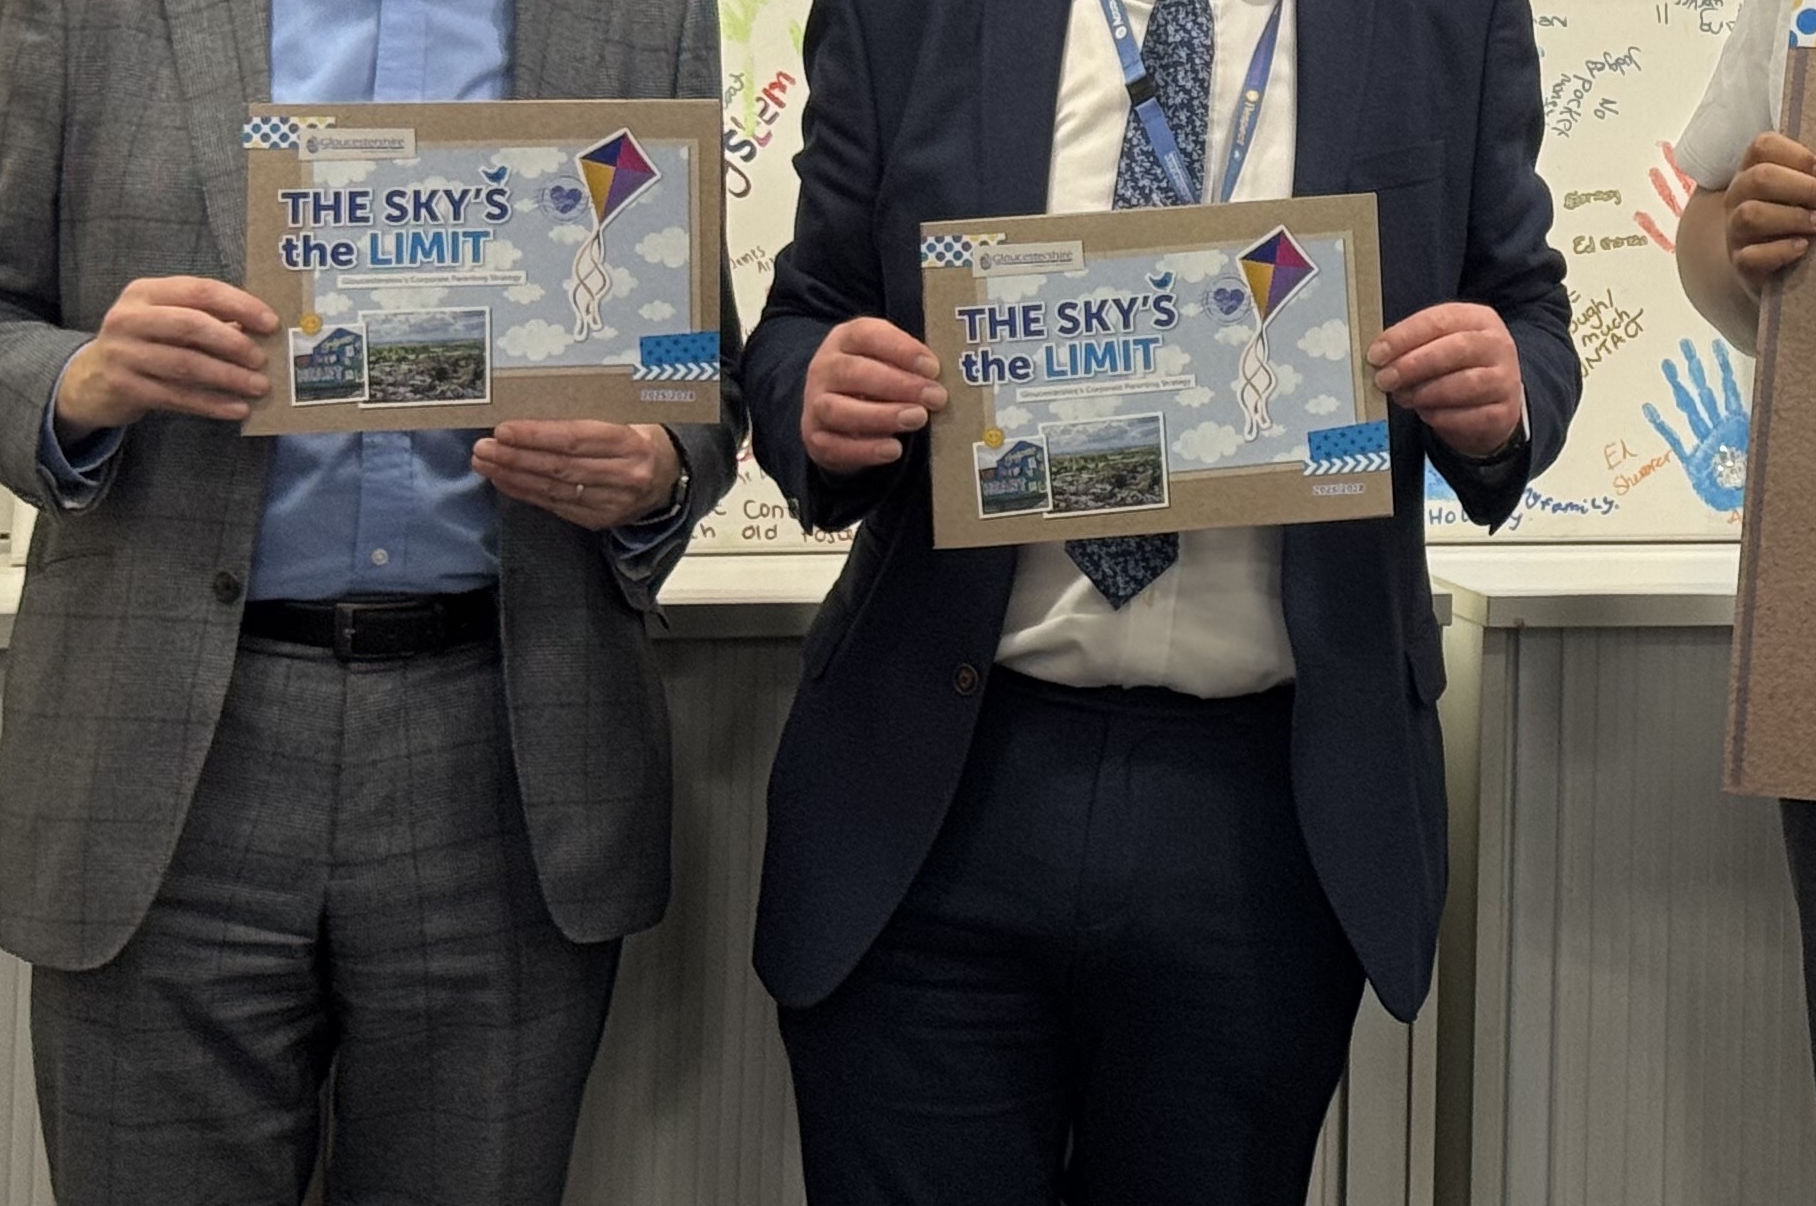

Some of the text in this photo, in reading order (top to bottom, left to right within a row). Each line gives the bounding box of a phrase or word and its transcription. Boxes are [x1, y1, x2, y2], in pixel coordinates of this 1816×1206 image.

[279, 187, 511, 226] THE SKY'S
[280, 229, 491, 269] the LIMIT
[956, 294, 1179, 344] THE SKY'S
[961, 336, 1162, 385] the LIMIT
[741, 524, 778, 541] old
